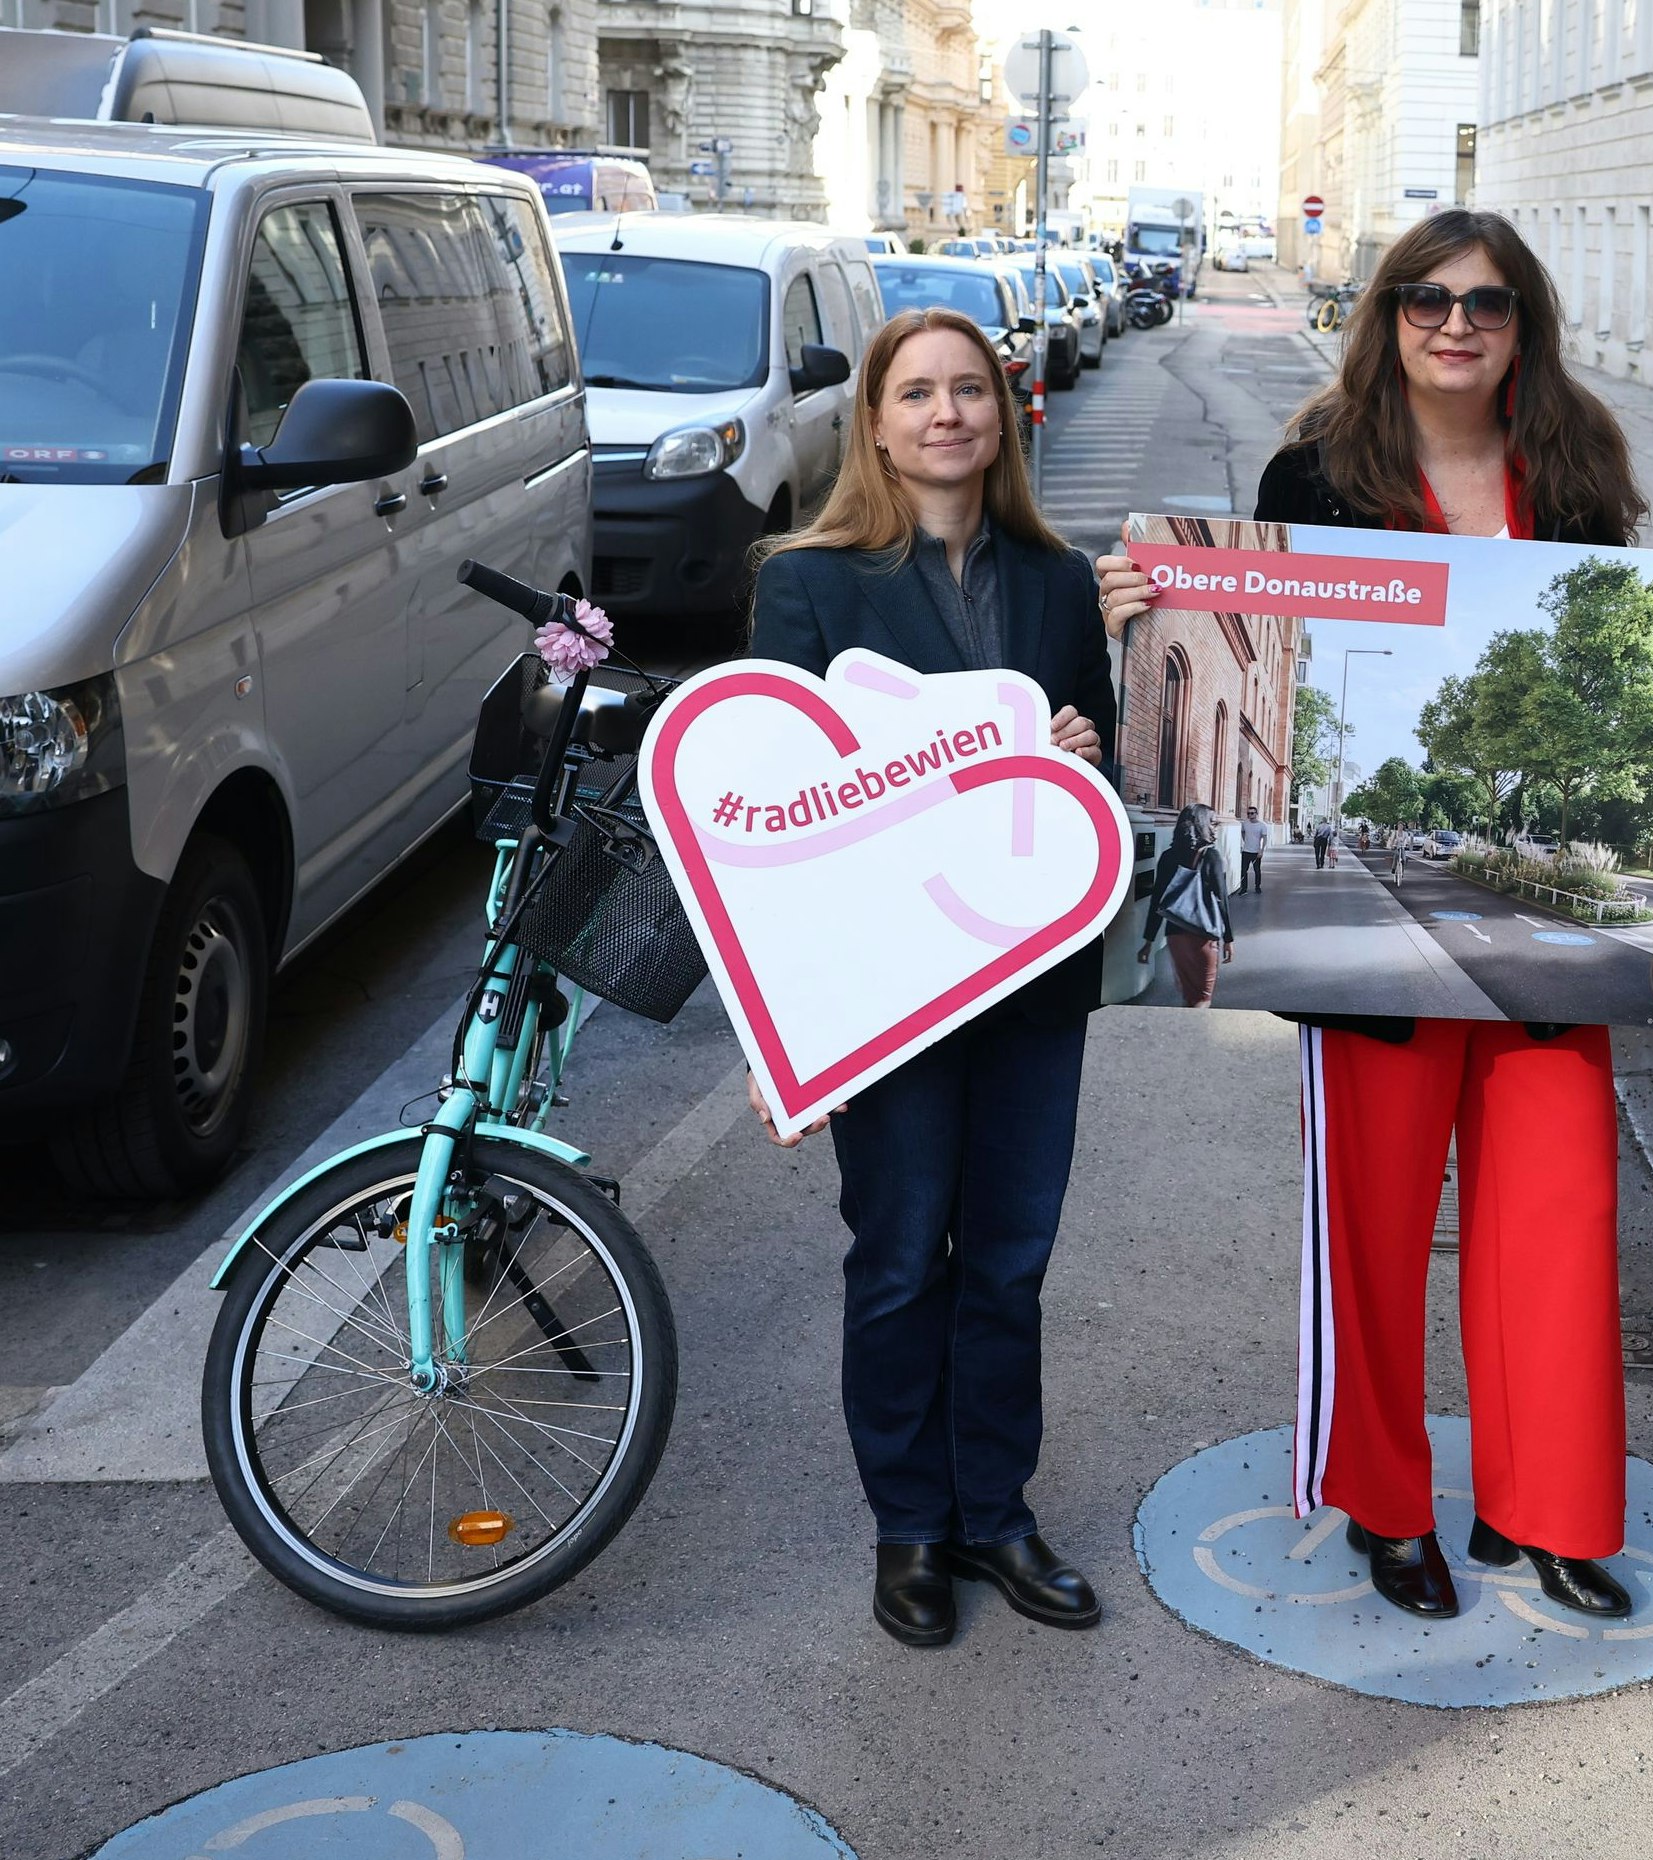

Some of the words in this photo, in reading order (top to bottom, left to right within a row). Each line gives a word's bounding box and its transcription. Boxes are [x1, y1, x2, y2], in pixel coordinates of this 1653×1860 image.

[9, 450, 73, 459] ORF
[1151, 564, 1237, 592] Obere
[1244, 570, 1422, 605] Donaustraße
[713, 720, 1002, 832] #radliebewien
